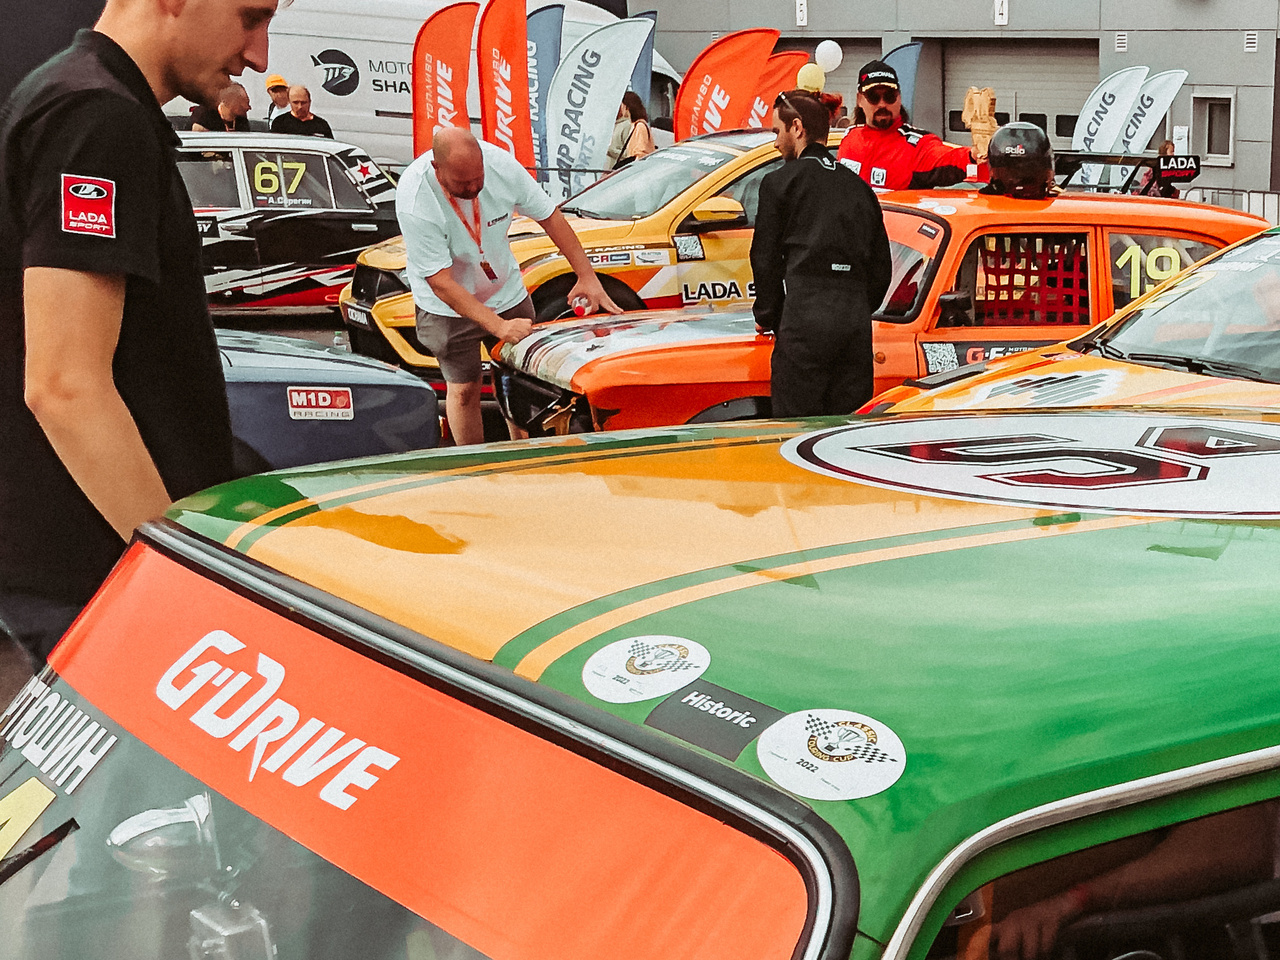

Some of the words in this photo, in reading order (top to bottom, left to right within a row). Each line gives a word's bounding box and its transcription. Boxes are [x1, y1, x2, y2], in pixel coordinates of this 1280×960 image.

[561, 48, 601, 143] RACING
[1160, 157, 1196, 169] LADA
[254, 162, 306, 194] 67
[69, 210, 108, 224] LADA
[69, 221, 111, 231] SPORT
[1116, 246, 1180, 299] 19
[683, 281, 742, 301] LADA
[291, 391, 332, 407] M1D
[681, 690, 757, 729] Historic
[838, 721, 877, 745] CLASSIC
[796, 758, 819, 773] 2022
